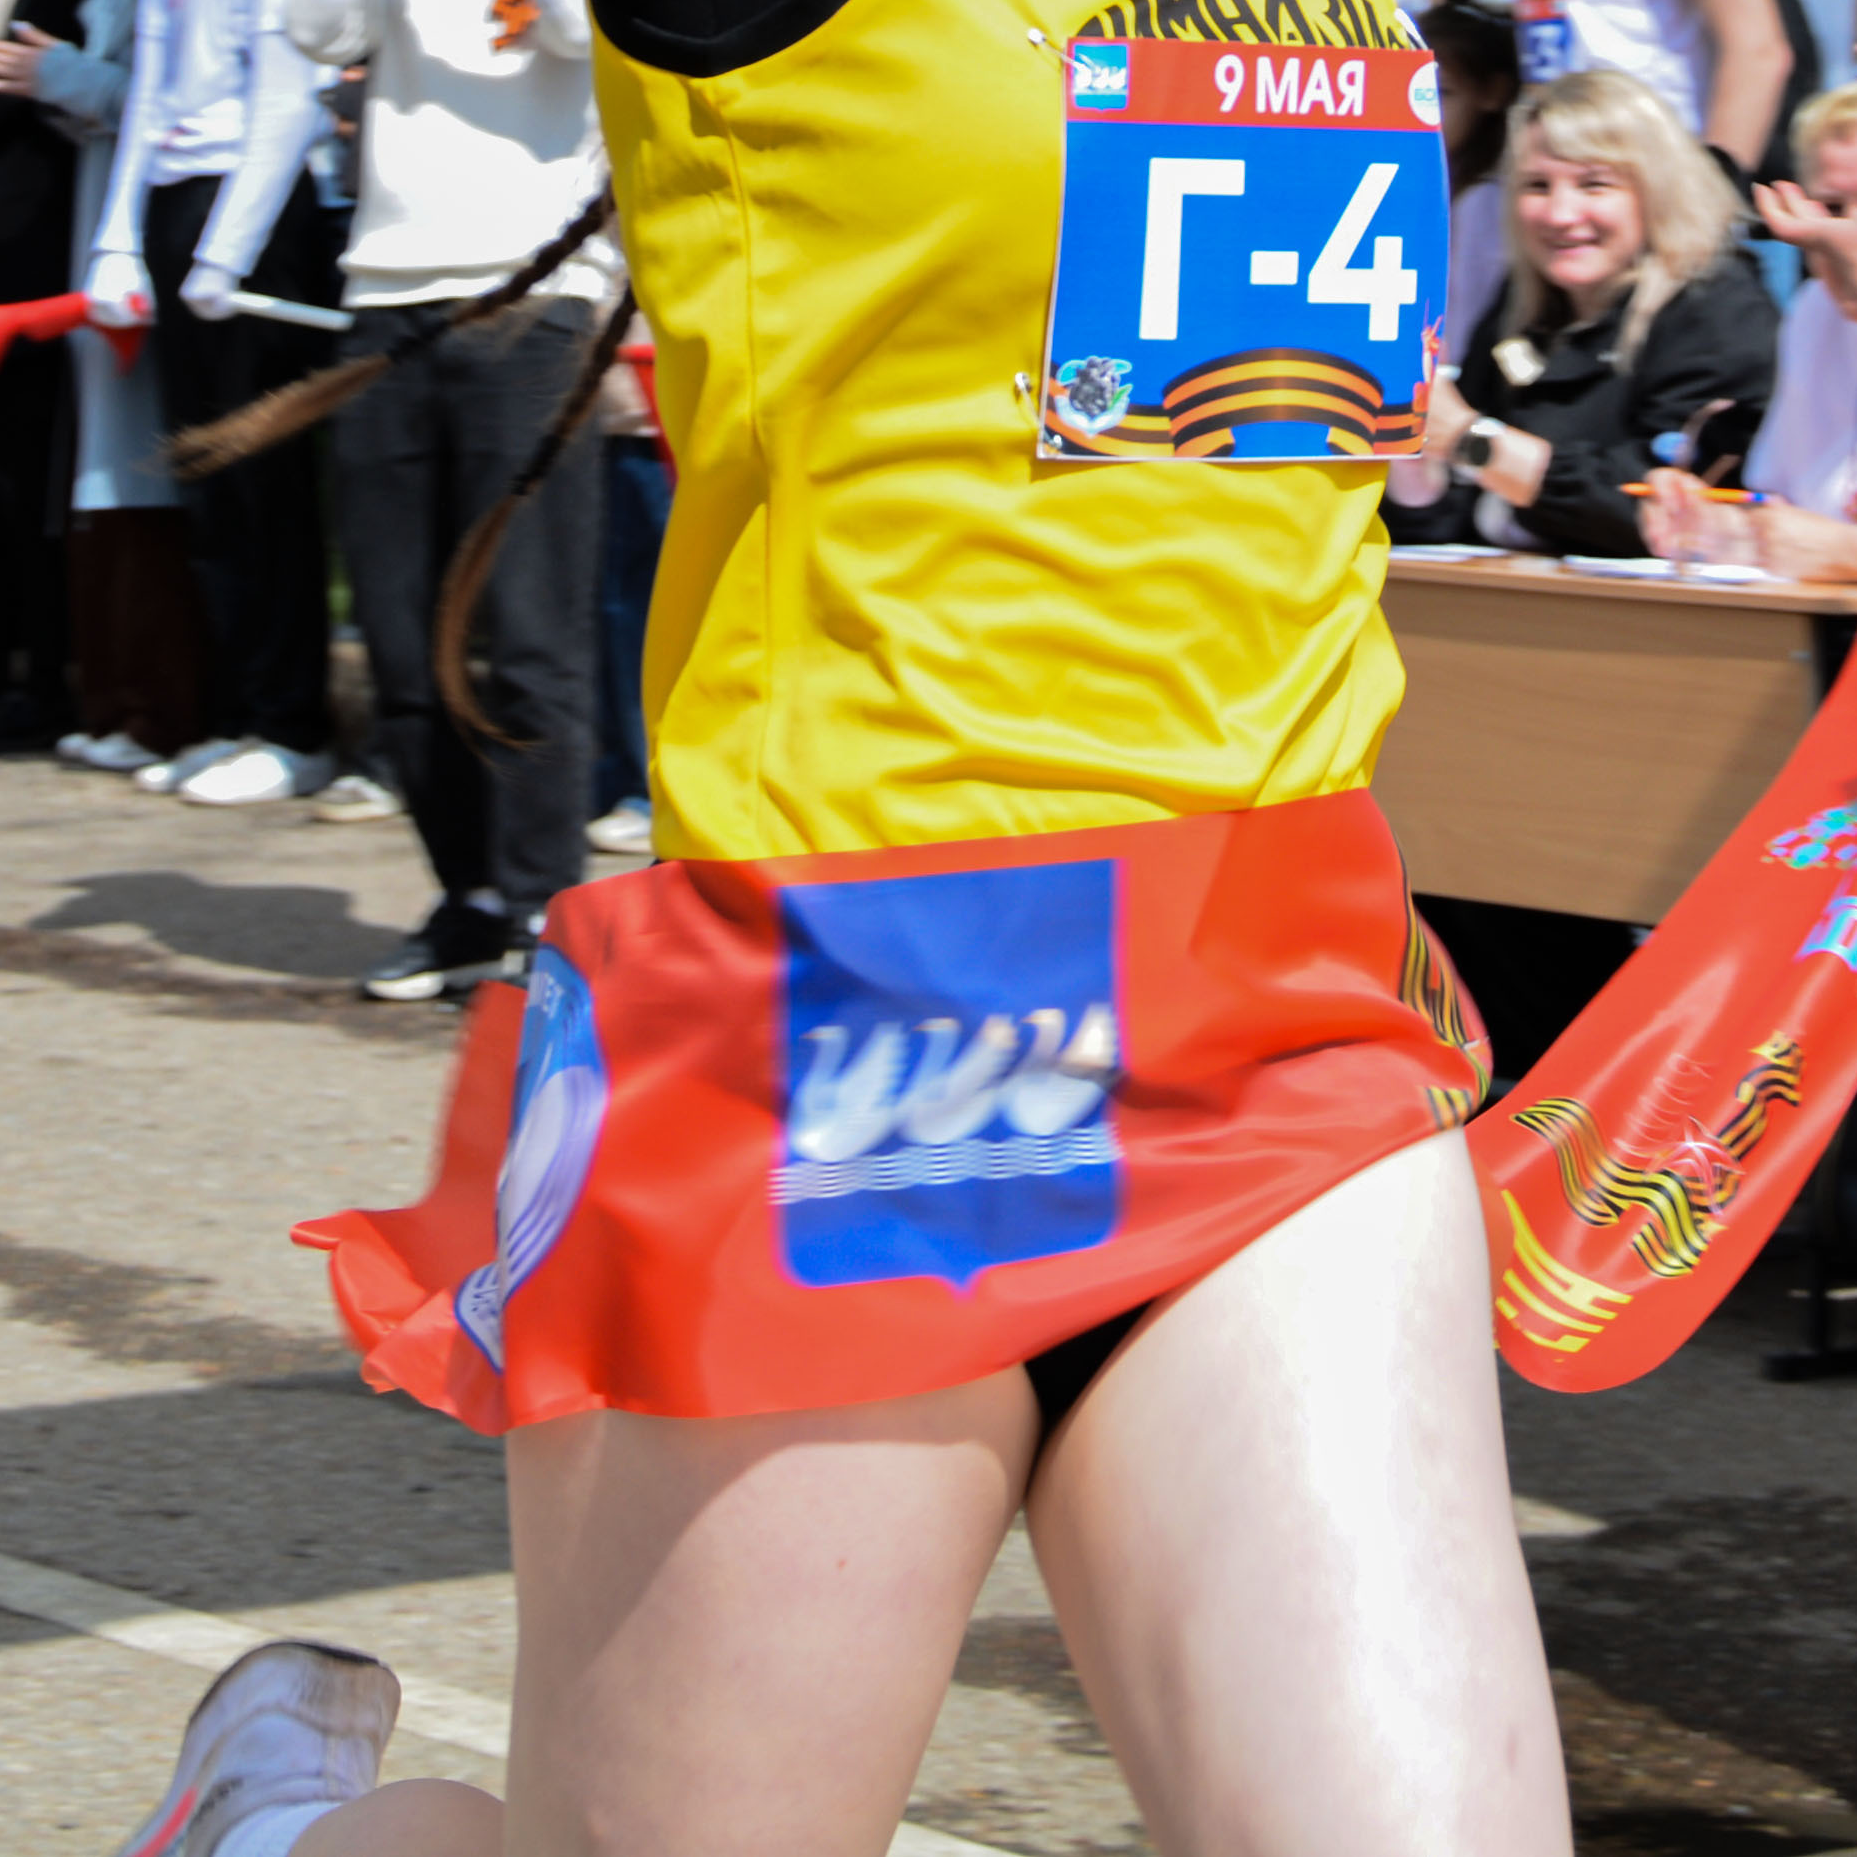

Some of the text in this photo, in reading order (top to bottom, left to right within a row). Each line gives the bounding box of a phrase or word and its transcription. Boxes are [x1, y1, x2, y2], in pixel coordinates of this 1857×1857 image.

[1214, 54, 1366, 117] 9 МАЯ
[1139, 157, 1418, 341] Г-4
